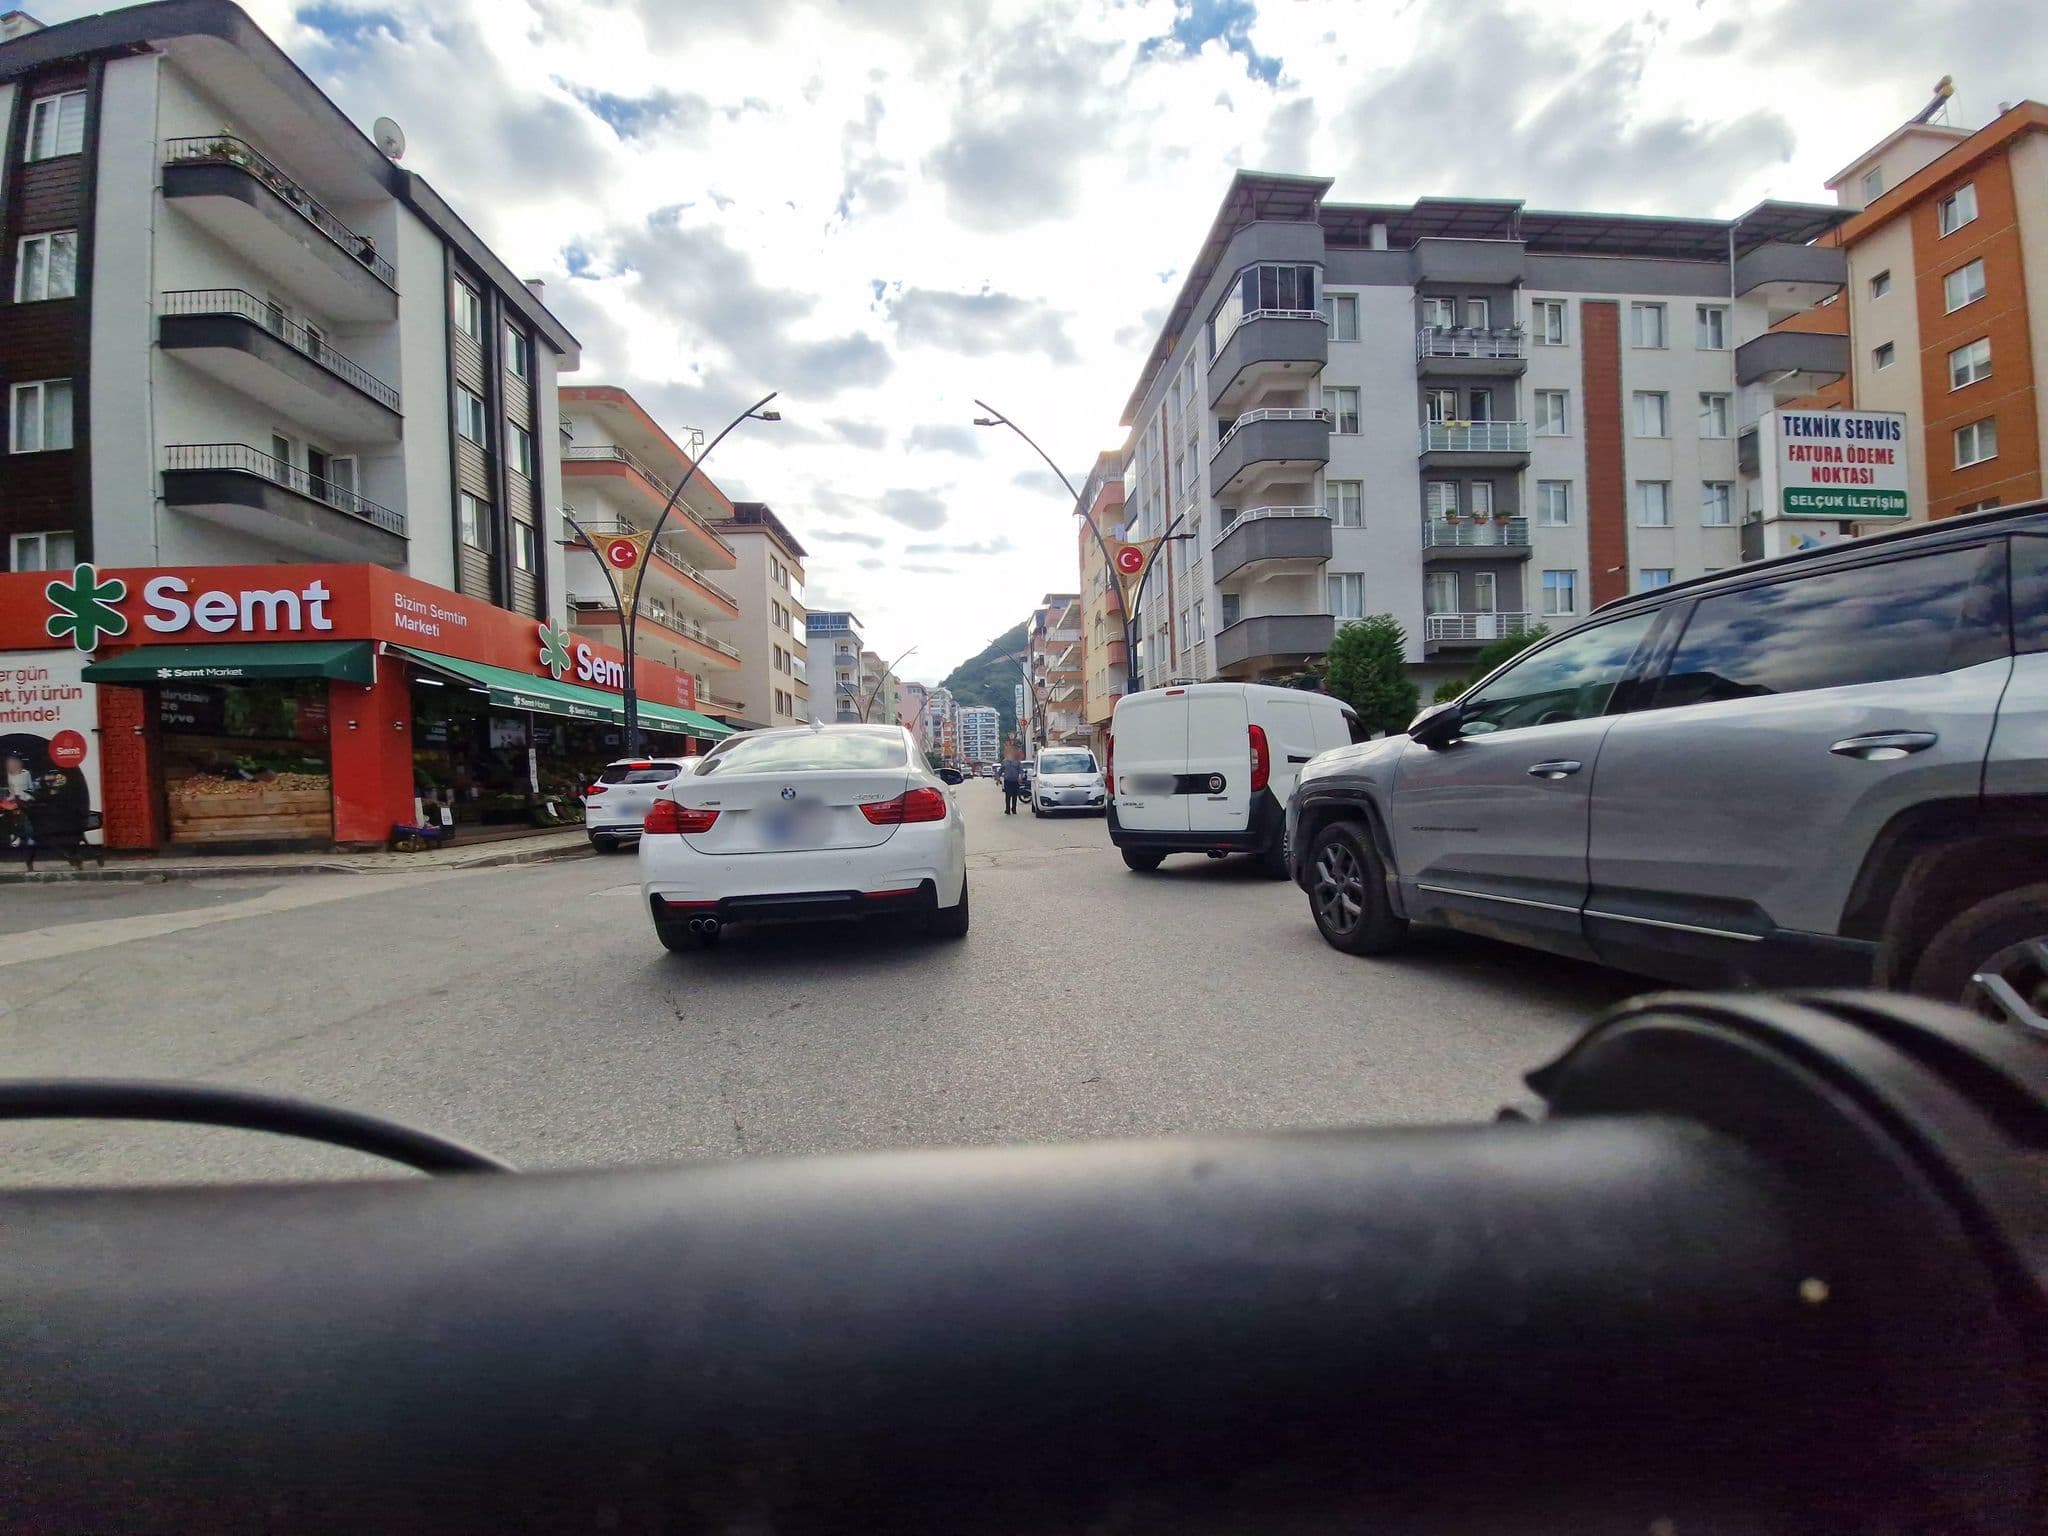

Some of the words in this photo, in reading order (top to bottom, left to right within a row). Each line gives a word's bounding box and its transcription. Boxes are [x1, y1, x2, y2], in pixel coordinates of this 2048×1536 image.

[1783, 415, 1841, 438] TEKNİK
[1845, 417, 1901, 441] SERVİS
[1788, 444, 1843, 463] FATURA
[1846, 444, 1895, 465] ÖDEME
[1811, 466, 1874, 485] NOKTASI
[1790, 494, 1844, 509] SELÇUK
[1847, 495, 1905, 511] İLETİŞİM
[143, 575, 332, 632] Semt
[394, 592, 427, 615] Bizim
[430, 603, 467, 626] Semtin
[395, 612, 440, 637] Marketi
[16, 665, 48, 684] gün
[174, 669, 205, 677] Semt
[206, 668, 243, 676] Market
[577, 643, 625, 689] Sem
[18, 686, 37, 704] iyi
[41, 684, 82, 700] ürün
